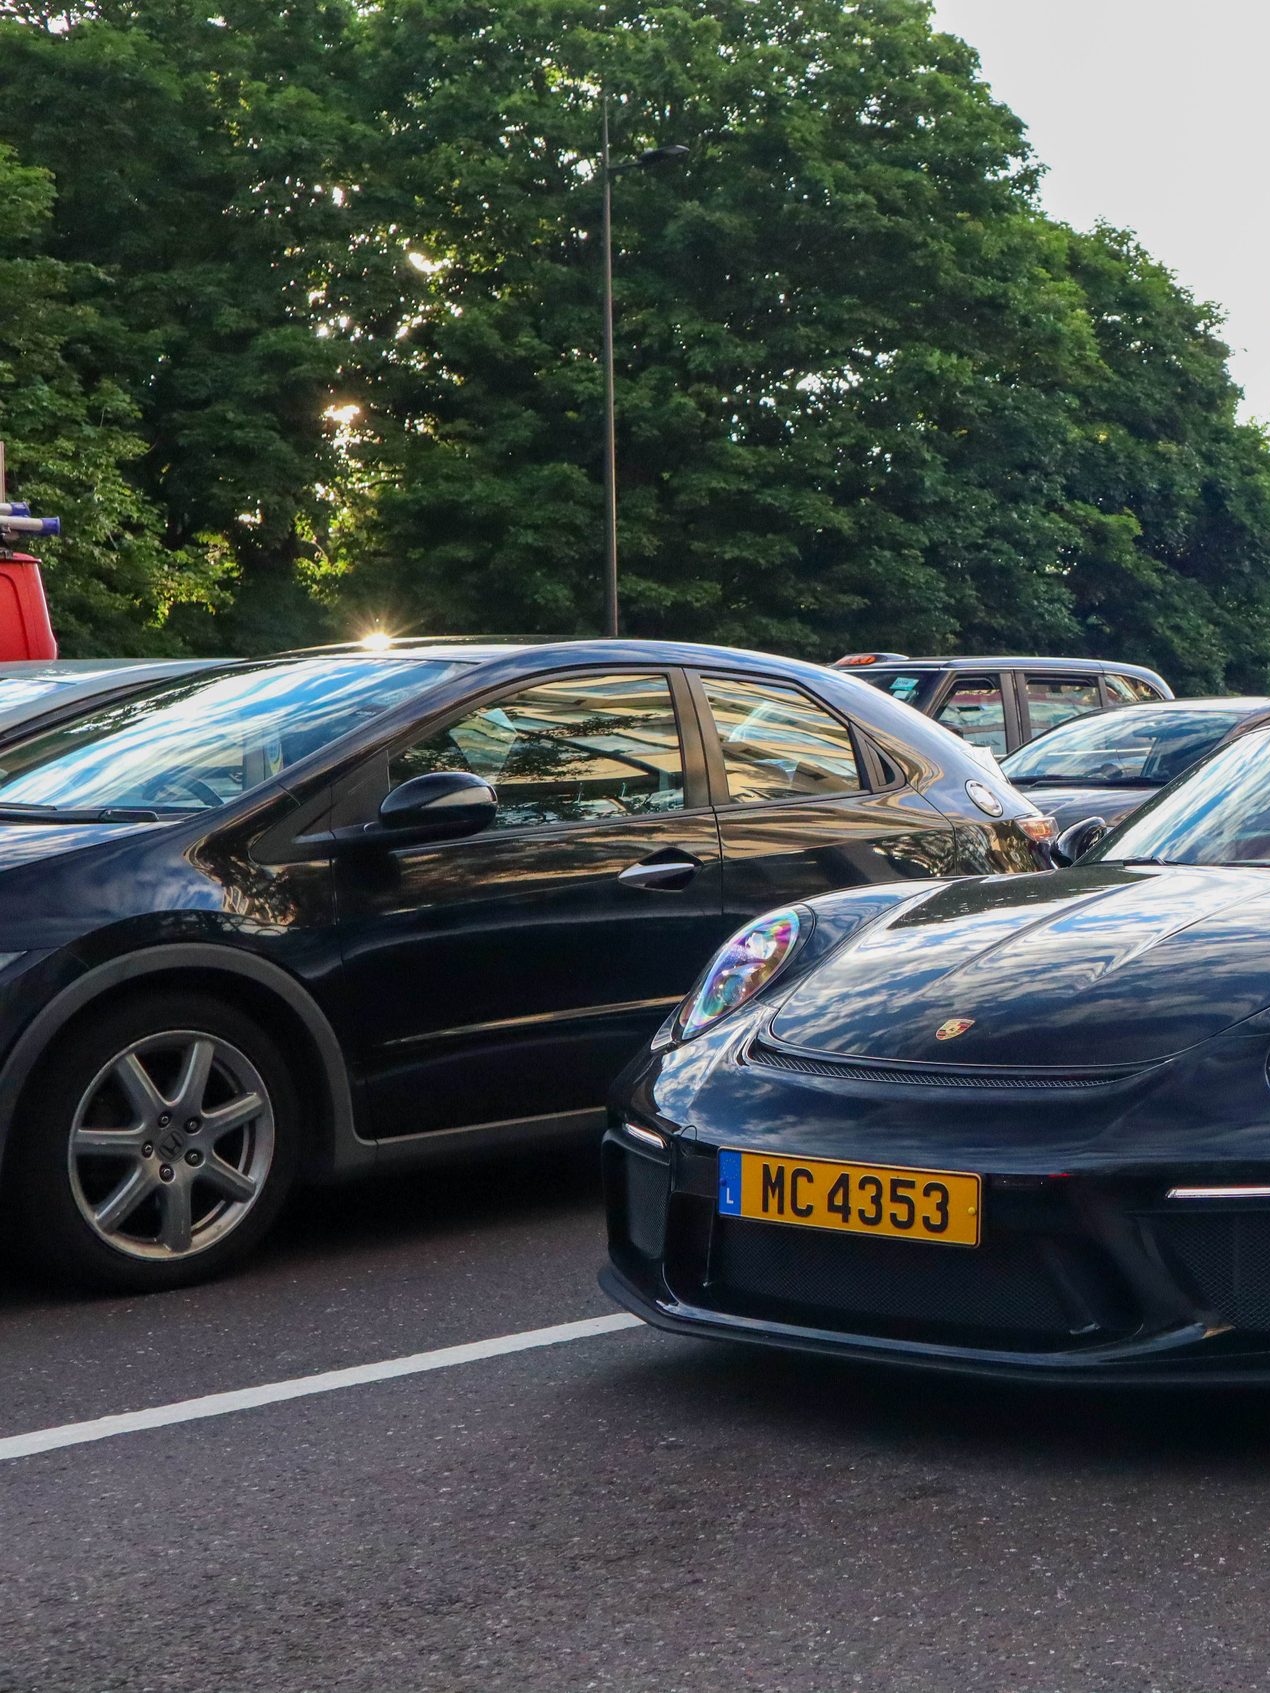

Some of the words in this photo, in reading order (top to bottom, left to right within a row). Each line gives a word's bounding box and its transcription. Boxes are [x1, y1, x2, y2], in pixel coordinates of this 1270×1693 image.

[726, 1188, 734, 1204] L
[762, 1163, 814, 1218] MC
[827, 1172, 949, 1233] 4353
